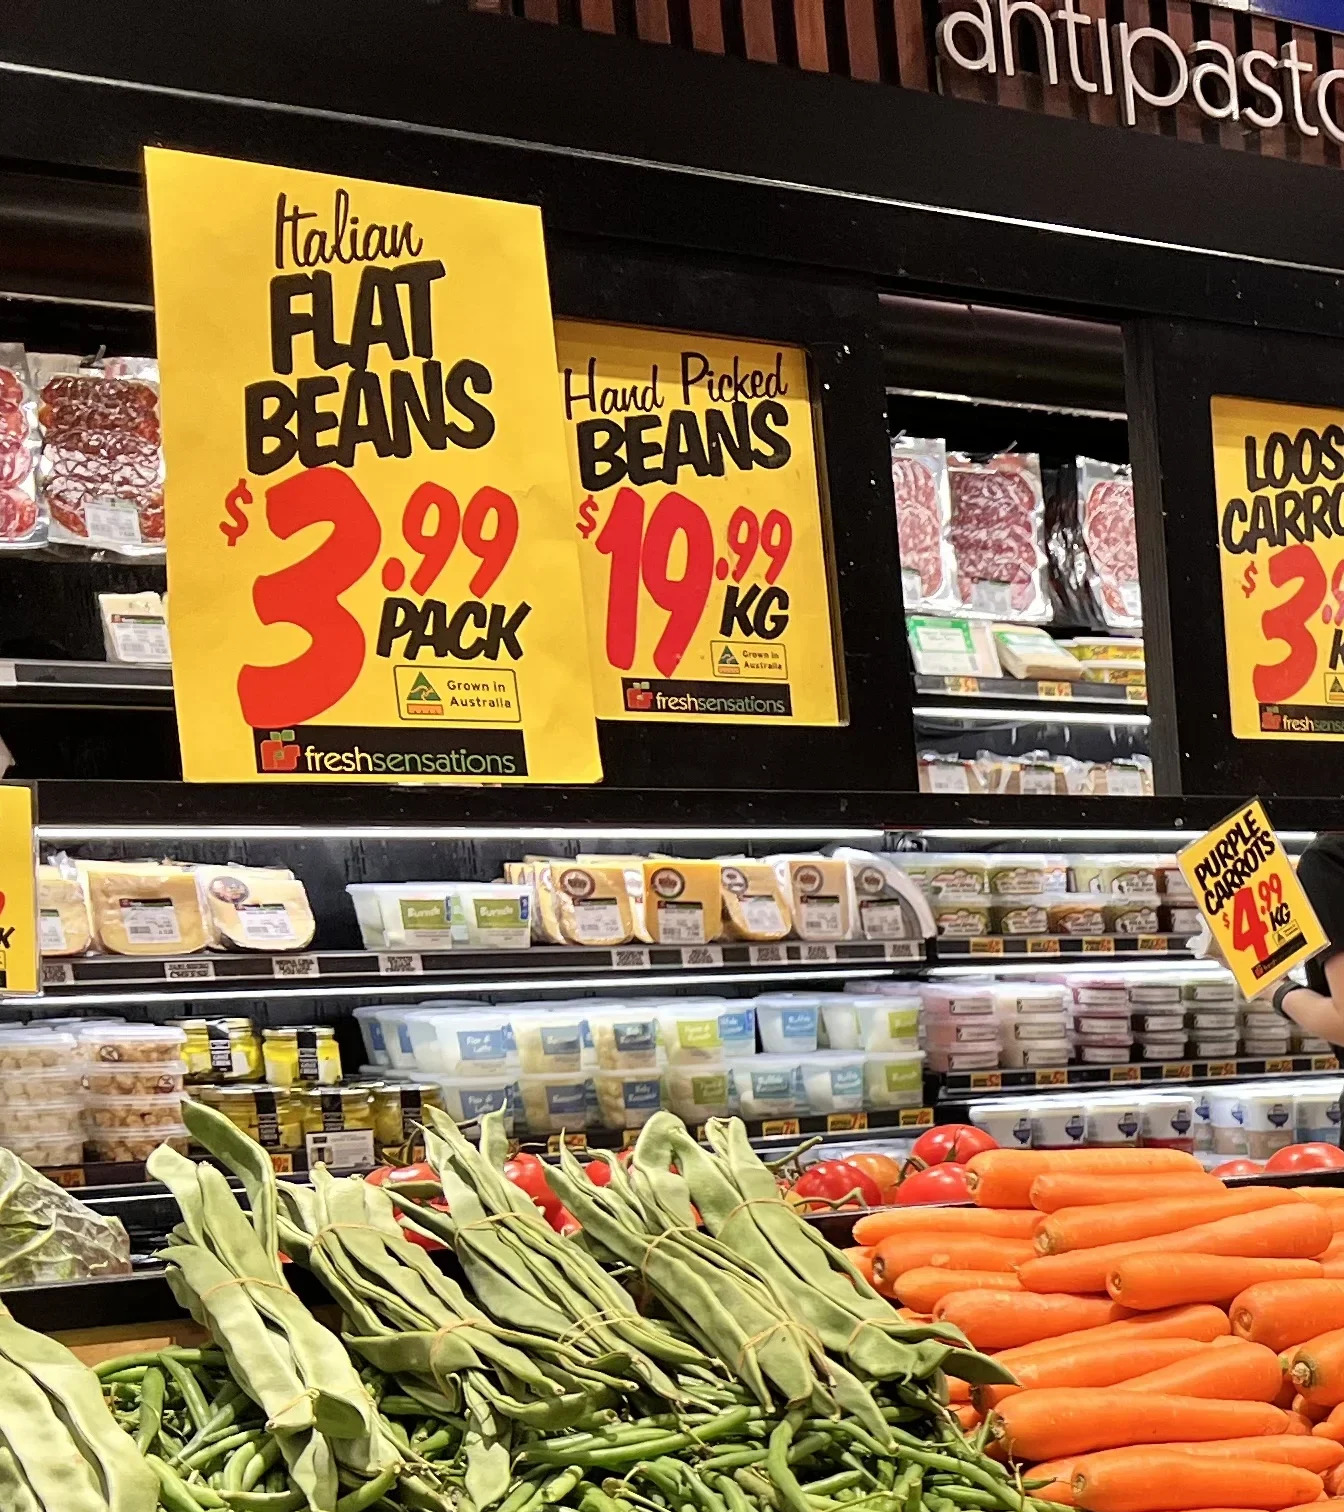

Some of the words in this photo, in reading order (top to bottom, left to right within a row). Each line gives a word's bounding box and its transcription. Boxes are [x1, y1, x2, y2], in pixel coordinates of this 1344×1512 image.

[274, 188, 423, 270] Italian
[271, 260, 447, 373] FLAT
[245, 359, 495, 475] BEANS
[565, 357, 663, 422] Hand
[679, 352, 788, 403] Picked
[577, 401, 792, 492] BEANS
[376, 596, 529, 661] PACK
[719, 586, 789, 641] KG
[743, 649, 767, 660] Grown
[744, 660, 782, 671] Australia
[447, 679, 487, 693] Grown
[492, 679, 506, 692] in
[449, 695, 511, 709] Australia
[655, 691, 785, 714] freshsensations
[304, 745, 516, 775] freshsensations
[1194, 809, 1261, 891] PURPLE
[1204, 830, 1275, 915] CARROTS
[1270, 903, 1291, 931] KG
